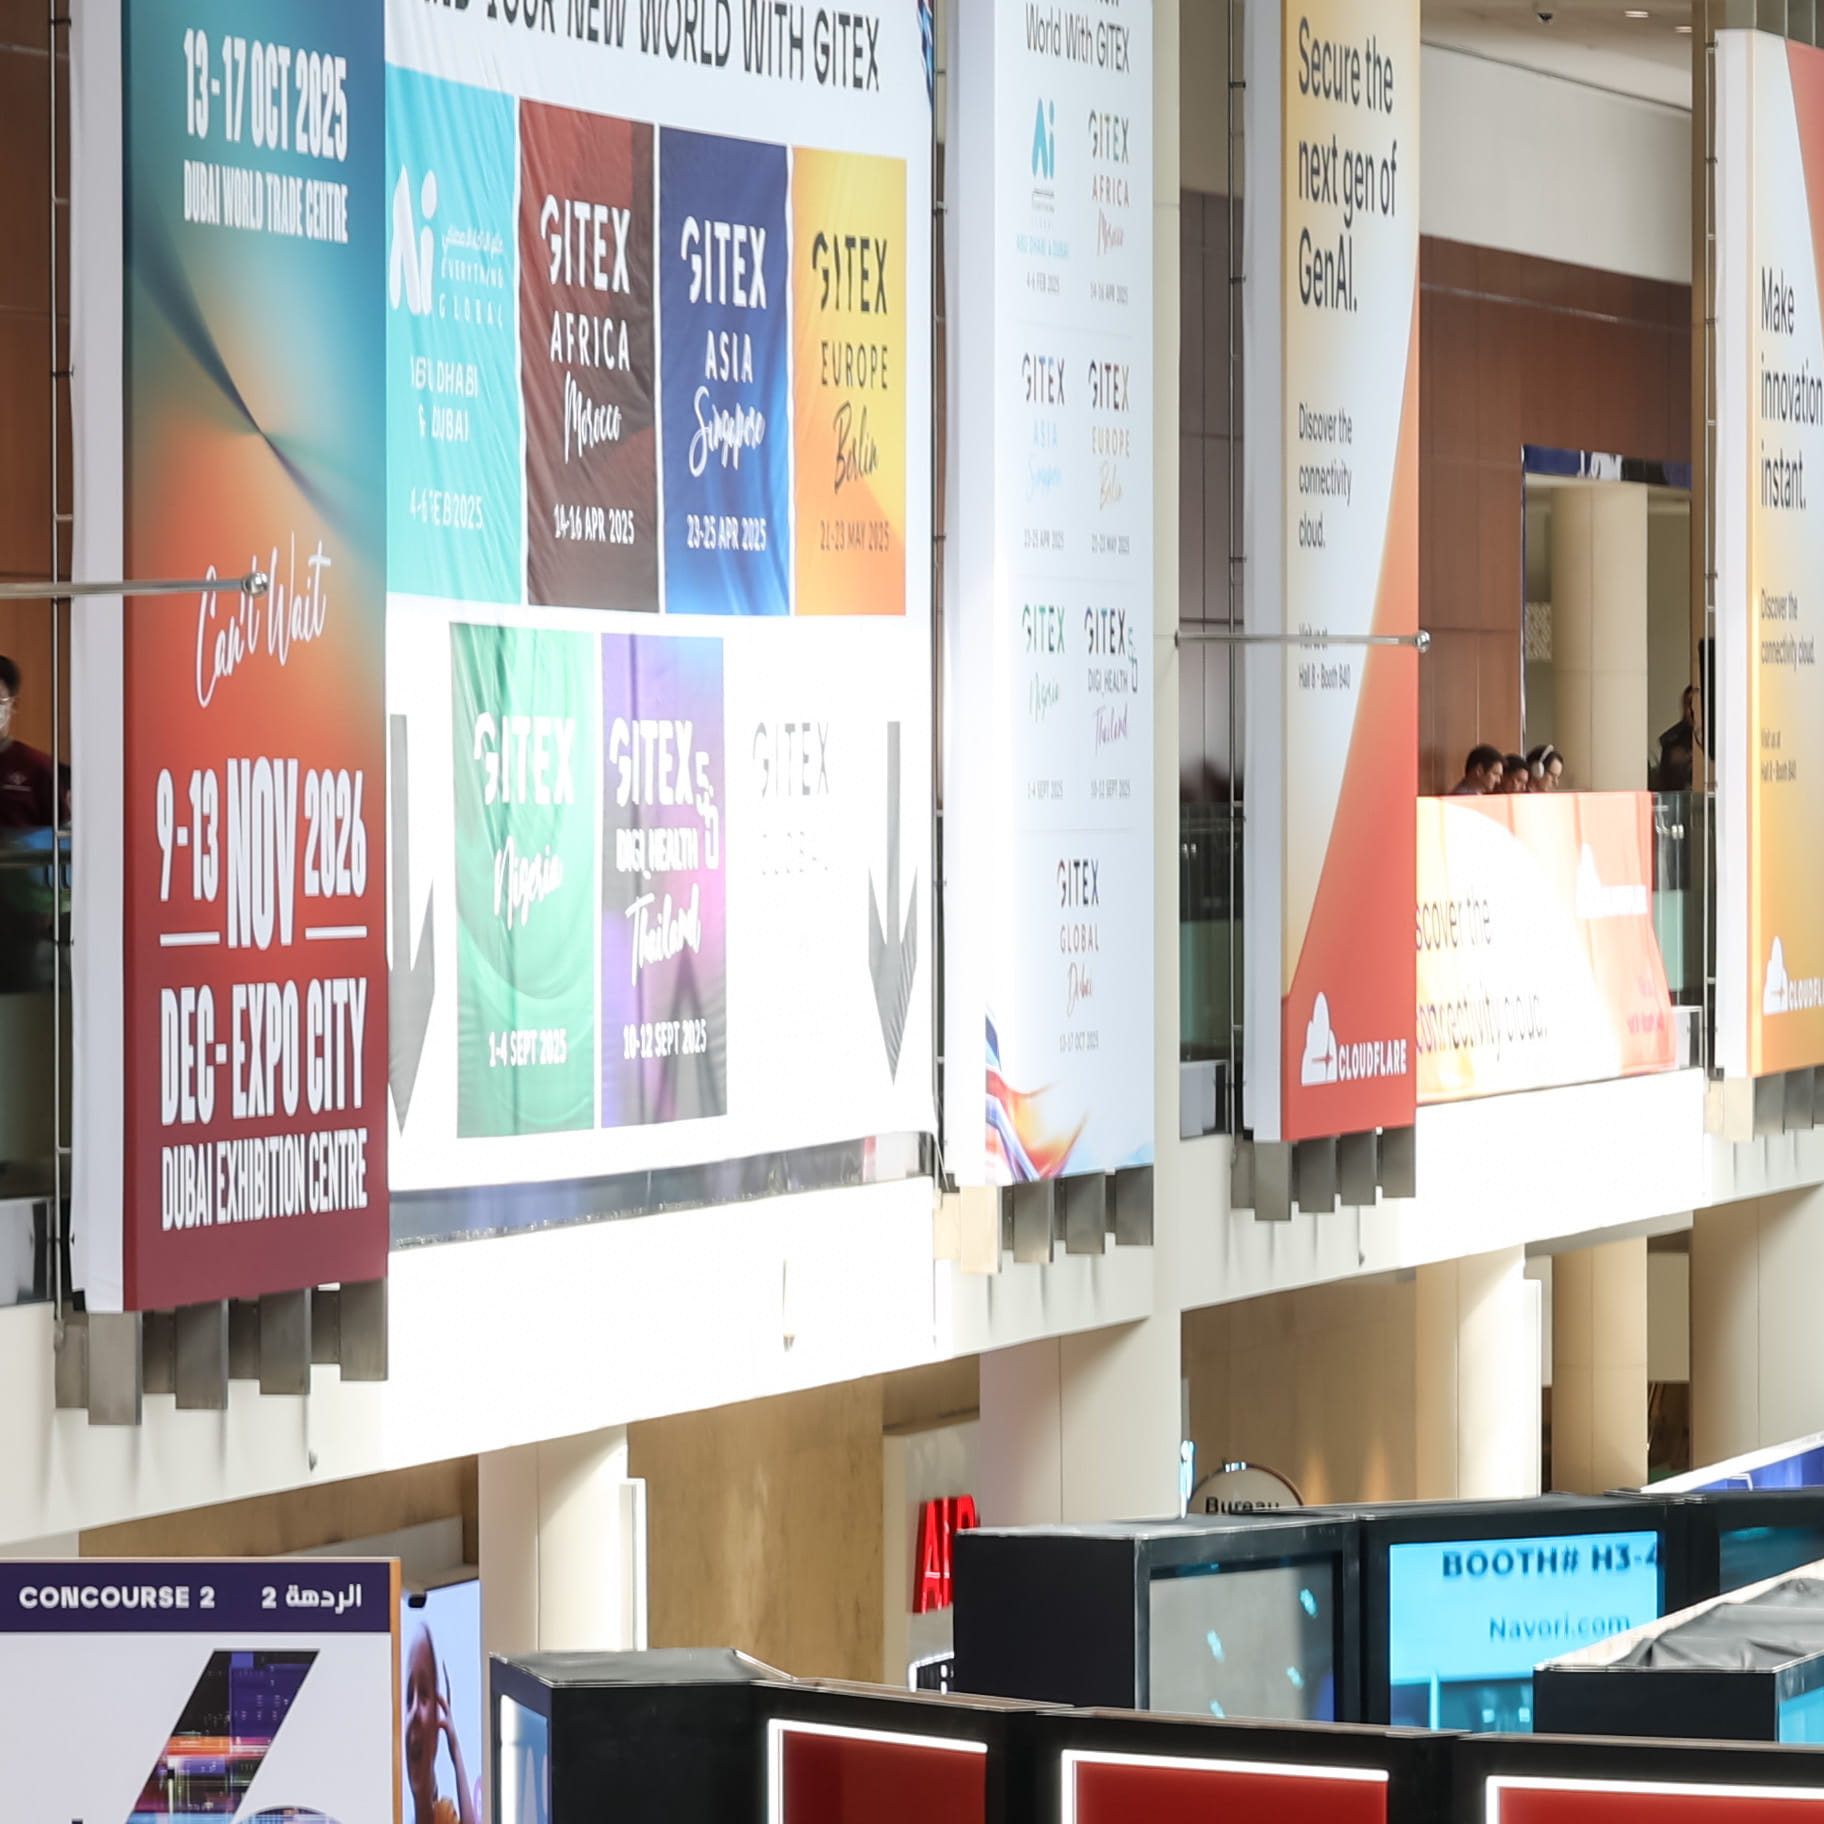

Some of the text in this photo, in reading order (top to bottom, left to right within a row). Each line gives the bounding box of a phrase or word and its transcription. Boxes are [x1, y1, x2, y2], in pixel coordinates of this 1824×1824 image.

[639, 0, 731, 68] WORLD
[743, 0, 804, 81] WITH
[812, 9, 881, 92] GITEX
[1026, 8, 1130, 73] World With GITEX
[1299, 16, 1394, 114] Secure the
[251, 40, 291, 152] OCT
[295, 48, 348, 162] 2025
[1089, 110, 1129, 164] GITEX
[184, 159, 348, 244] DUBAI WORLD TRADE CENTRE
[1092, 174, 1130, 207] AFRICA
[1299, 135, 1397, 228] next gen of
[541, 195, 631, 294] GITEX
[681, 216, 766, 310] GITEX
[812, 231, 888, 315] GITEX
[1299, 227, 1358, 312] GenAI.
[1761, 267, 1794, 336] Make
[551, 312, 631, 372] AFRICA
[704, 330, 753, 383] ASIA
[823, 341, 889, 390] EUROPE
[1022, 352, 1065, 406] GITEX
[1089, 360, 1130, 413] GITEX
[1761, 357, 1823, 428] innovation
[564, 370, 623, 463] Morocco
[689, 385, 766, 477] Singapore
[833, 400, 879, 494] Berlin
[1299, 403, 1353, 445] Discover the
[1299, 460, 1352, 505] connectivity
[1761, 443, 1806, 510] instant.
[584, 506, 635, 545] APR 2025
[715, 516, 738, 551] APR
[268, 532, 331, 666] Wait
[1022, 605, 1066, 653] GITEX
[1084, 608, 1126, 657] GITEX
[474, 712, 575, 805] GITEX
[610, 717, 695, 807] GITEX
[227, 756, 367, 950] NOV 2026
[1057, 859, 1099, 908] GITEX
[625, 884, 702, 987] Thailand
[1060, 923, 1099, 954] GLOBAL
[307, 976, 367, 1114] CITY
[510, 1029, 567, 1066] SEPT 2025
[656, 1018, 706, 1057] SEPT 2025
[1337, 1039, 1408, 1081] CLOUDFLARE
[162, 1128, 368, 1231] DUBAI EXHIBITION CENTRE
[1442, 1546, 1580, 1579] BOOTH#
[18, 1585, 217, 1611] CONCOURSE 2
[261, 1584, 362, 1616] الردهة 2
